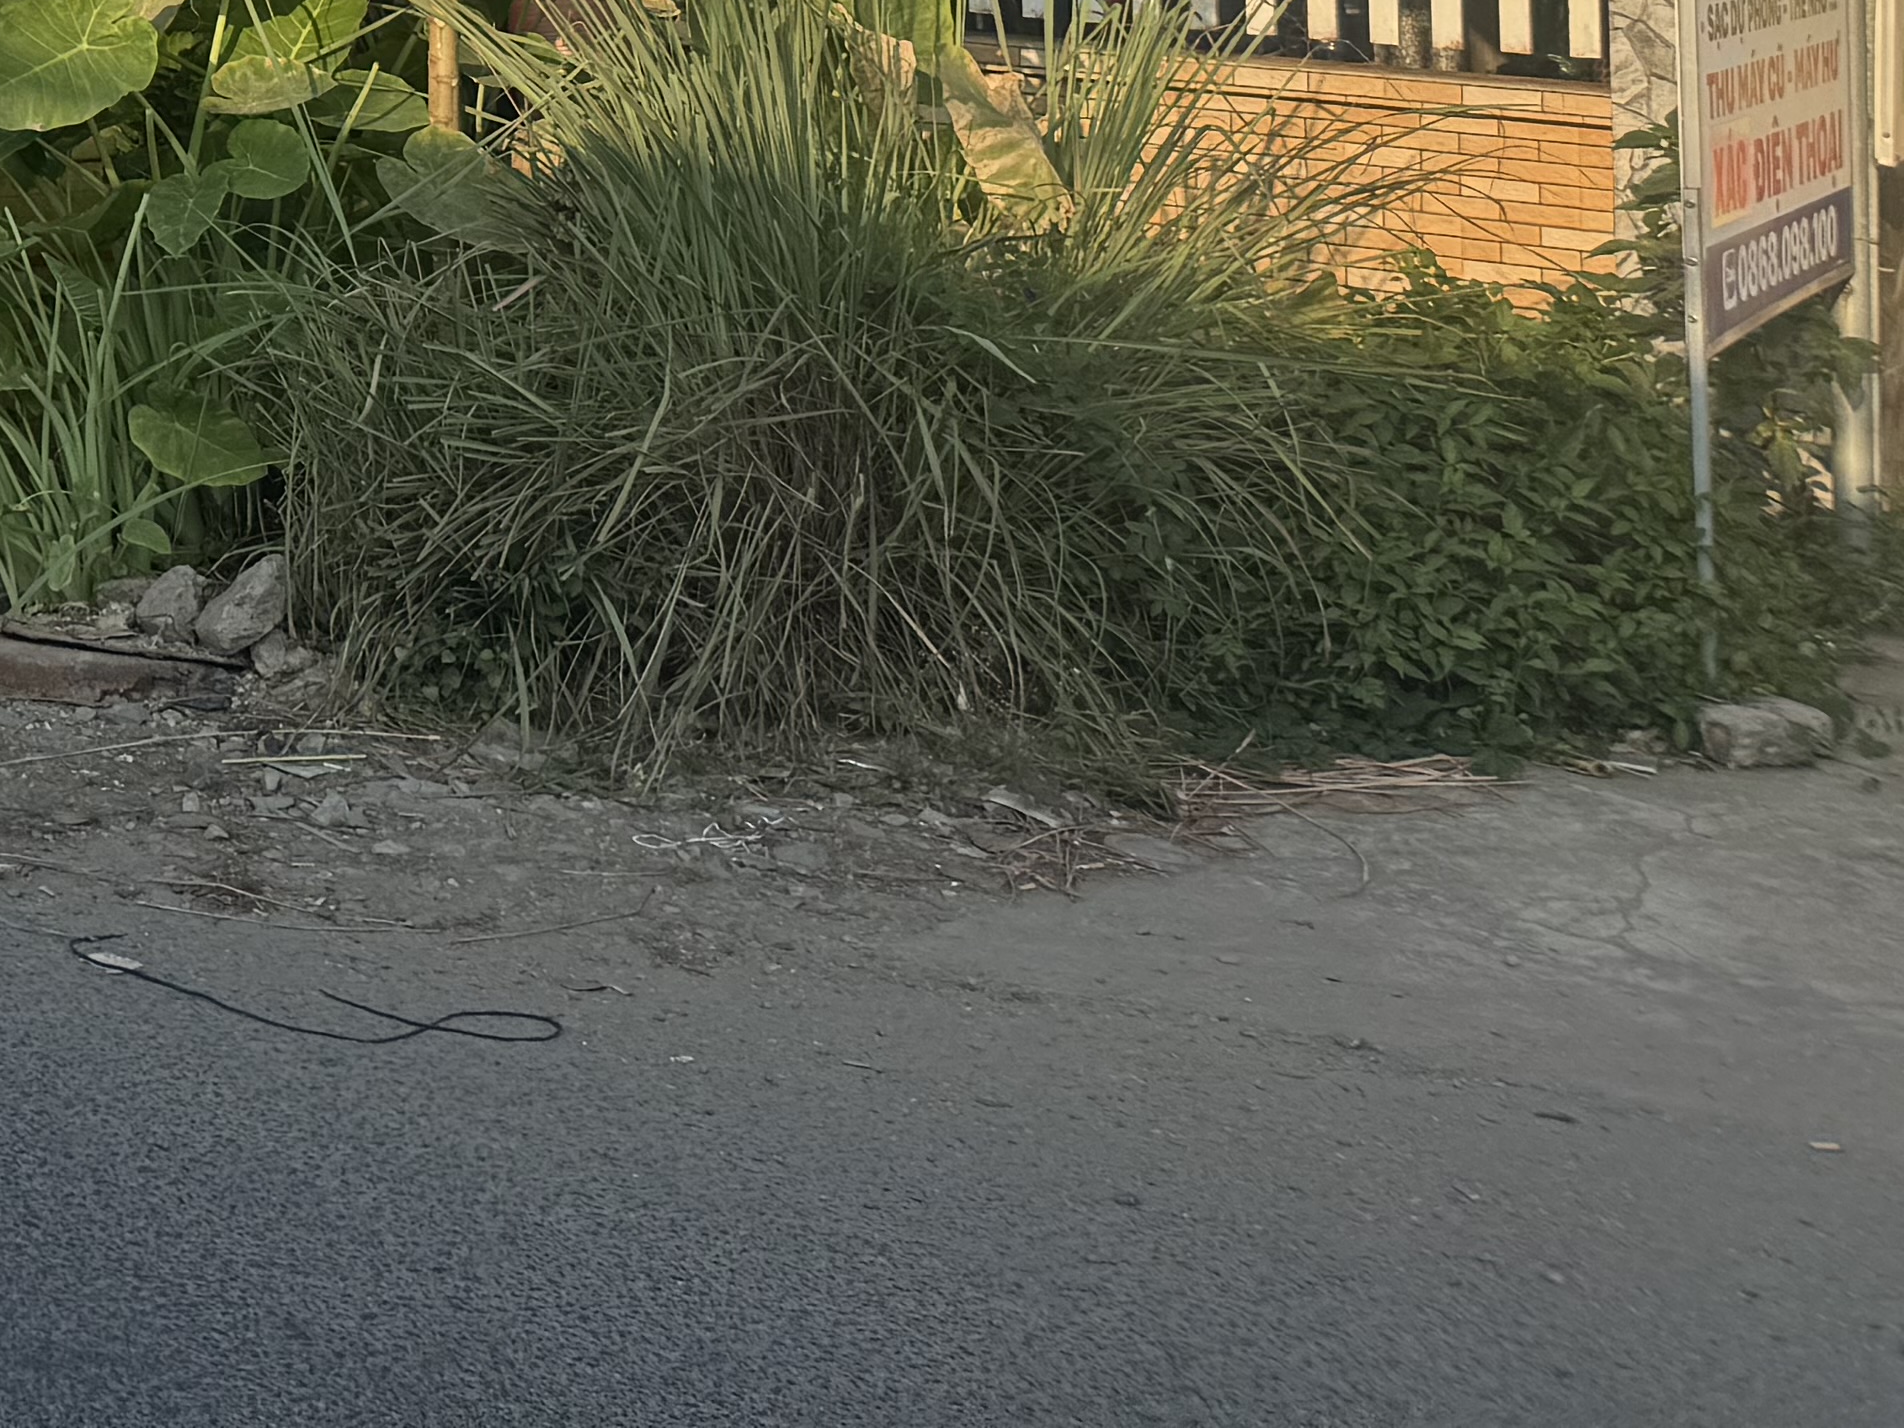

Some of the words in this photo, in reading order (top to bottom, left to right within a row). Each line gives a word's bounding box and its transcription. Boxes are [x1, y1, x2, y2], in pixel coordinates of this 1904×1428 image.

[1707, 1, 1729, 51] SẠC
[1706, 65, 1735, 120] THU
[1737, 48, 1766, 112] MÁY
[1767, 42, 1785, 102] CŨ
[1793, 33, 1820, 93] MÁY
[1712, 127, 1749, 219] XÁC
[1752, 114, 1794, 213] ĐIỆN
[1795, 108, 1844, 188] THOẠI
[1737, 203, 1838, 303] 0868.098.100
